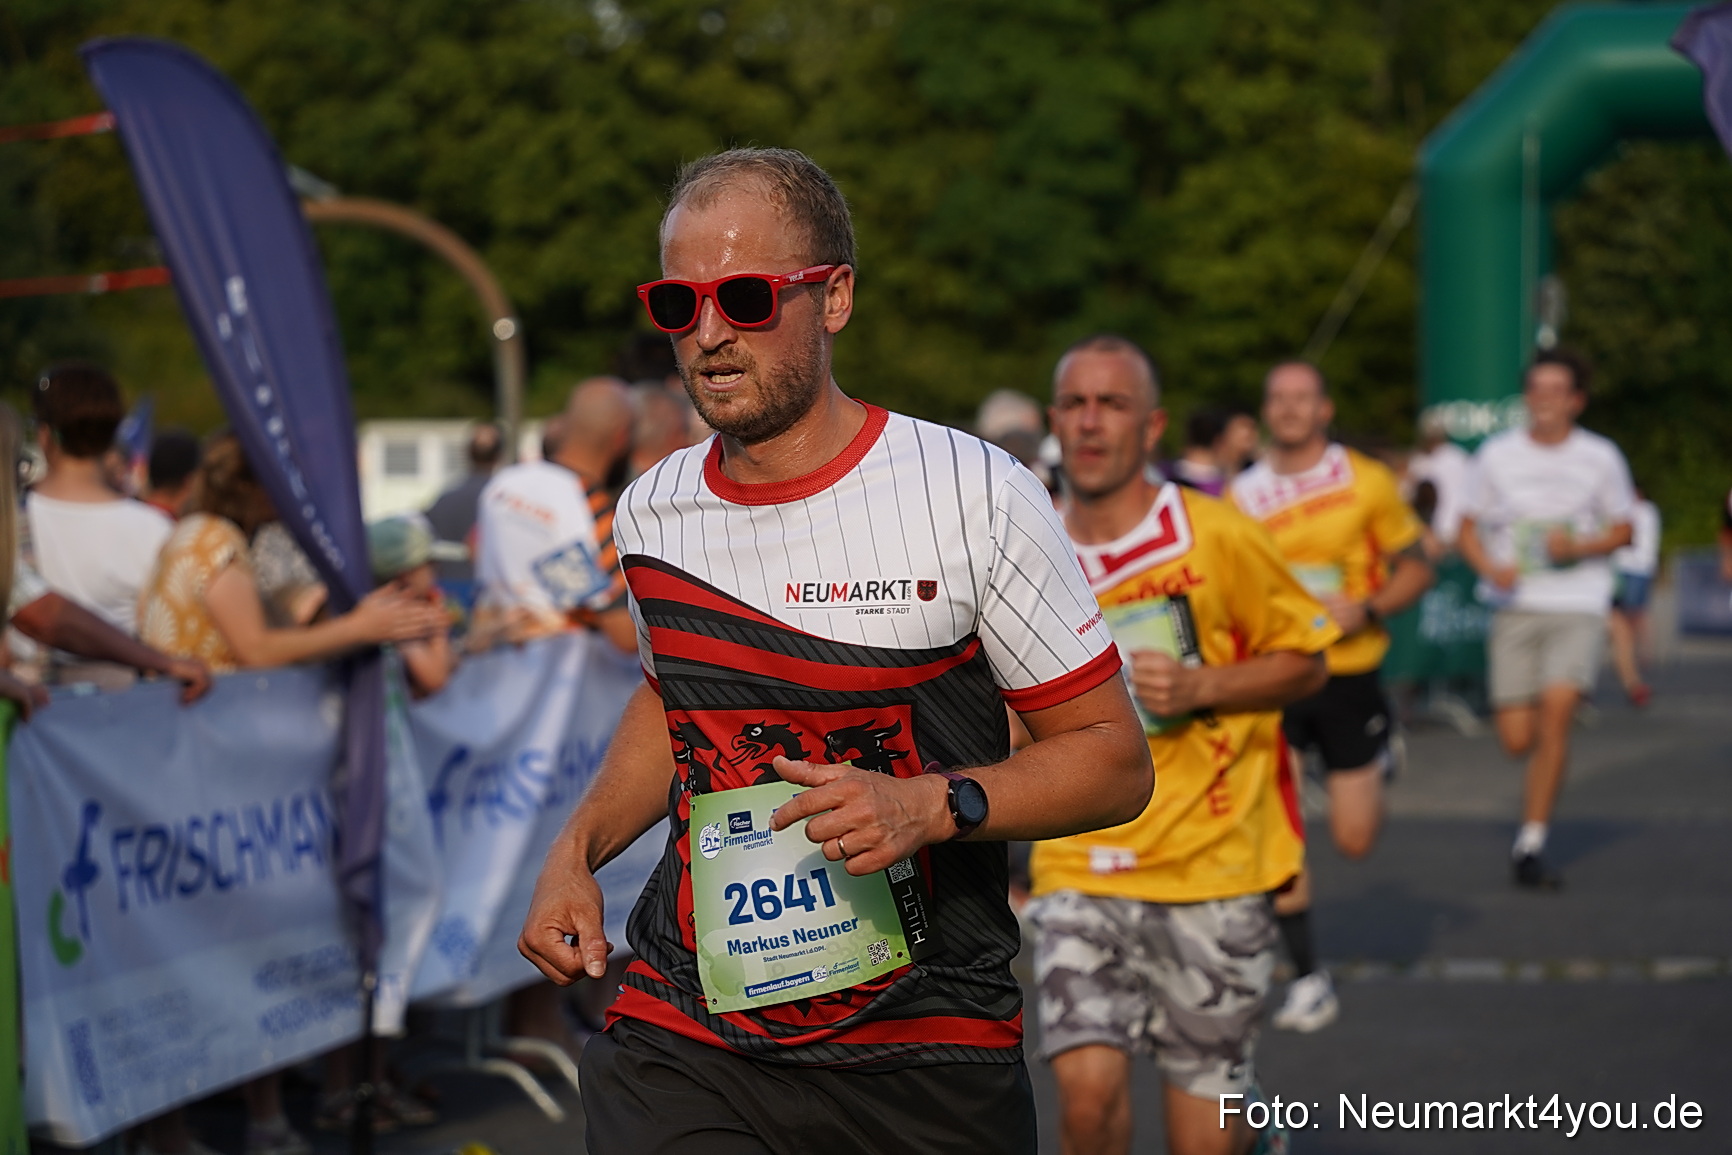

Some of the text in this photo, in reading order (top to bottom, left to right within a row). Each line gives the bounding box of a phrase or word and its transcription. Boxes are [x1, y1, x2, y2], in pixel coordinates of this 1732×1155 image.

[785, 580, 912, 603] NEUMARKT
[886, 607, 911, 615] STADT
[723, 827, 772, 848] Firmenlauf
[743, 837, 774, 851] neumarkt
[724, 867, 836, 926] 2641
[901, 885, 926, 944] HILTL
[726, 916, 860, 957] Markus Neuner
[762, 954, 778, 963] Stadt
[779, 949, 806, 960] Neumarkt
[748, 974, 811, 996] firmenlauf.bayern
